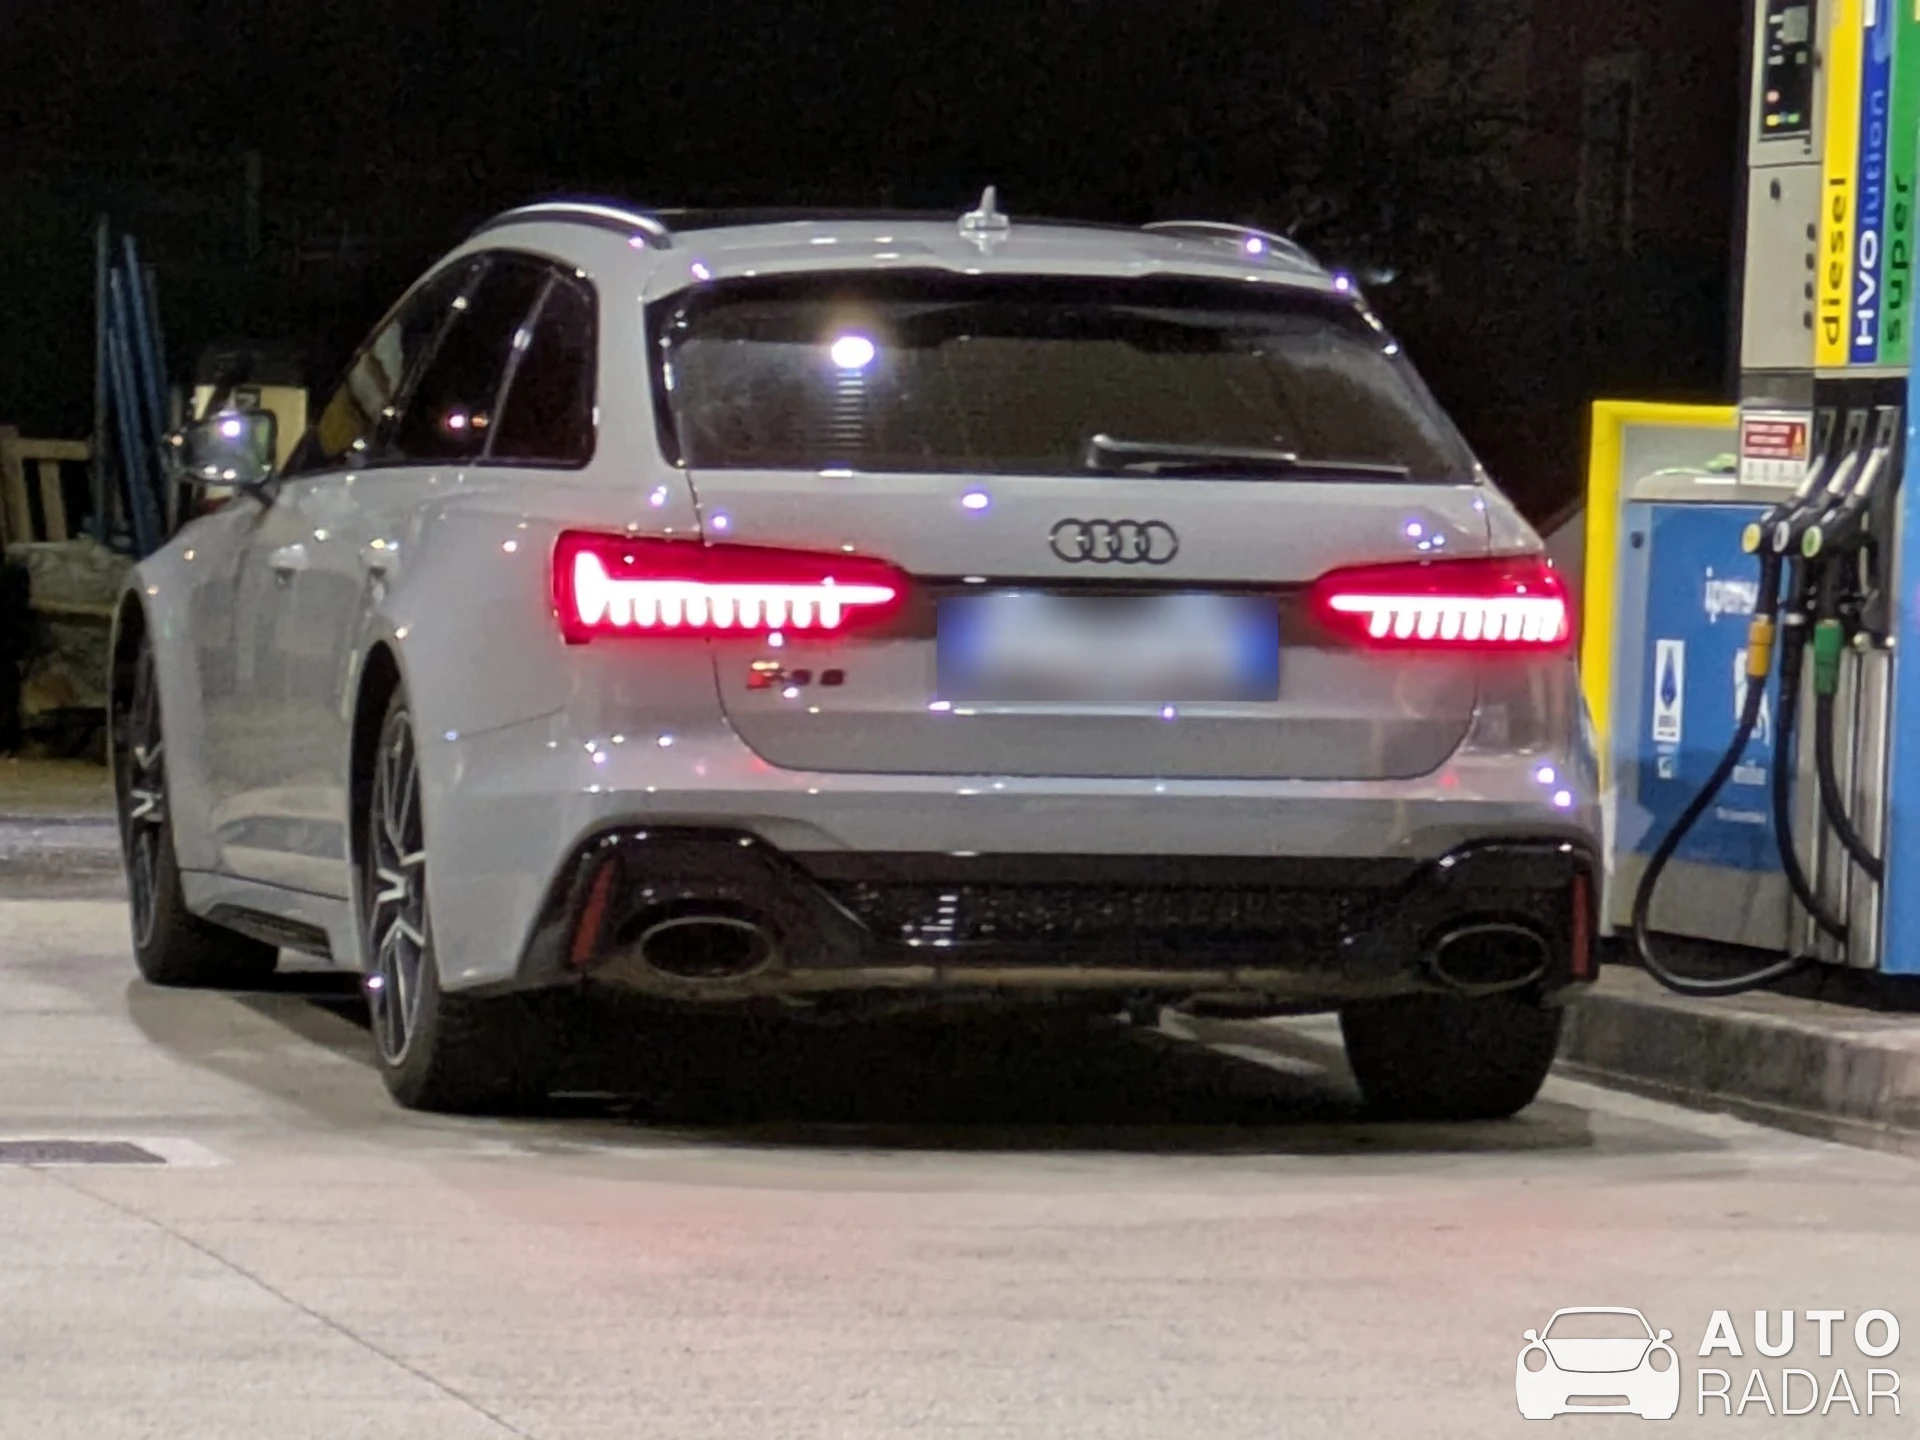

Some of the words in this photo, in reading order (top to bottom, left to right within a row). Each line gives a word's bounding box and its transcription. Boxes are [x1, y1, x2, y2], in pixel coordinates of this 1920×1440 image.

[1822, 177, 1847, 346] diesel
[1855, 89, 1886, 346] HVOlution
[1887, 173, 1908, 343] super
